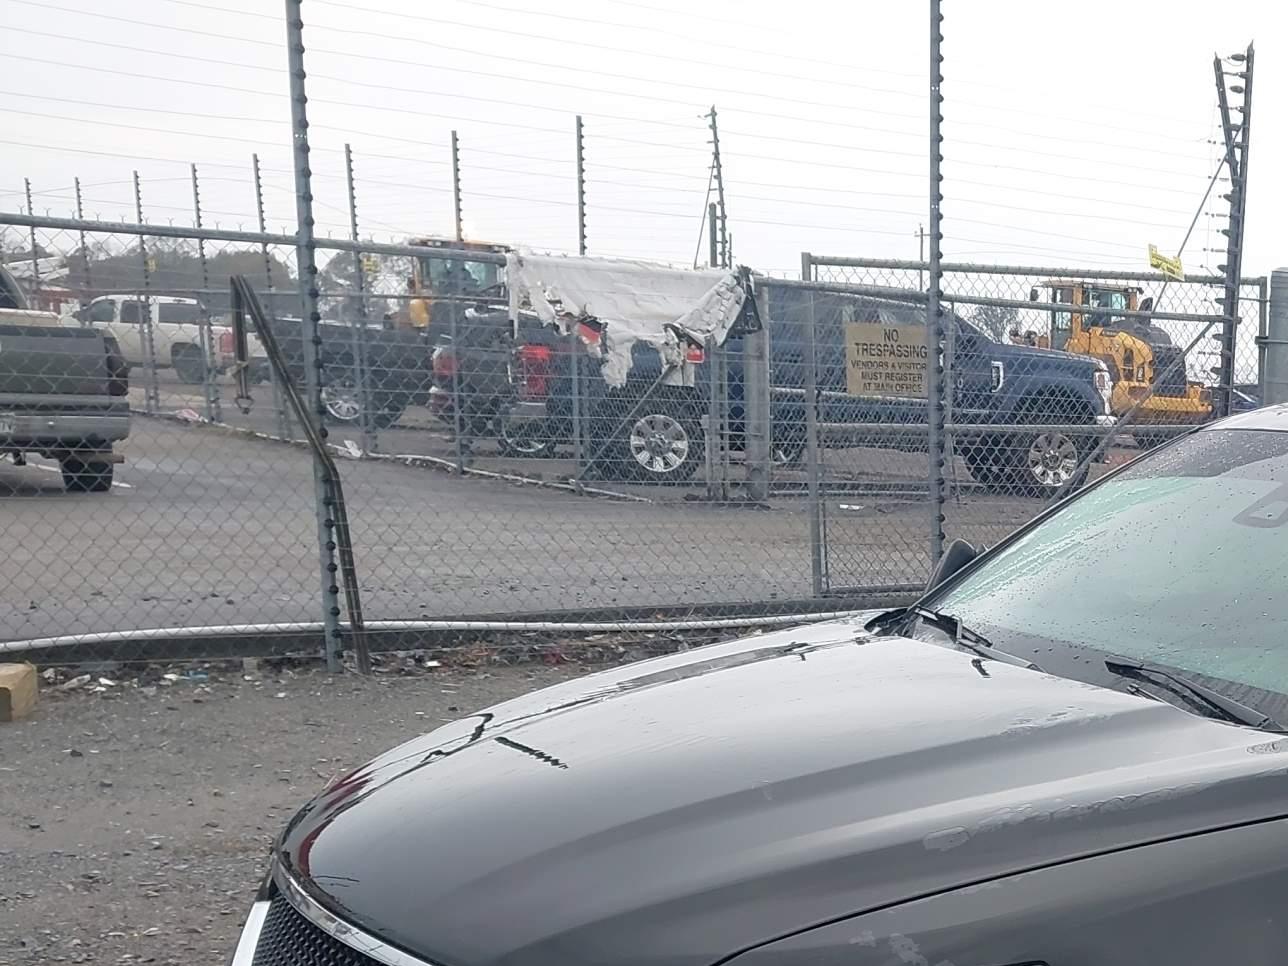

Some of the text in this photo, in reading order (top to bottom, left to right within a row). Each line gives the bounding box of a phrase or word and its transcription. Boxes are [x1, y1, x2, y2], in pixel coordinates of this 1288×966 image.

[883, 328, 899, 342] NO
[854, 342, 928, 359] TRESPASSING
[851, 359, 889, 370] VENDORS
[897, 361, 927, 371] VISITOR
[861, 371, 923, 383] MUST REGISTER
[863, 382, 872, 392] AT
[895, 383, 923, 393] OFFICE
